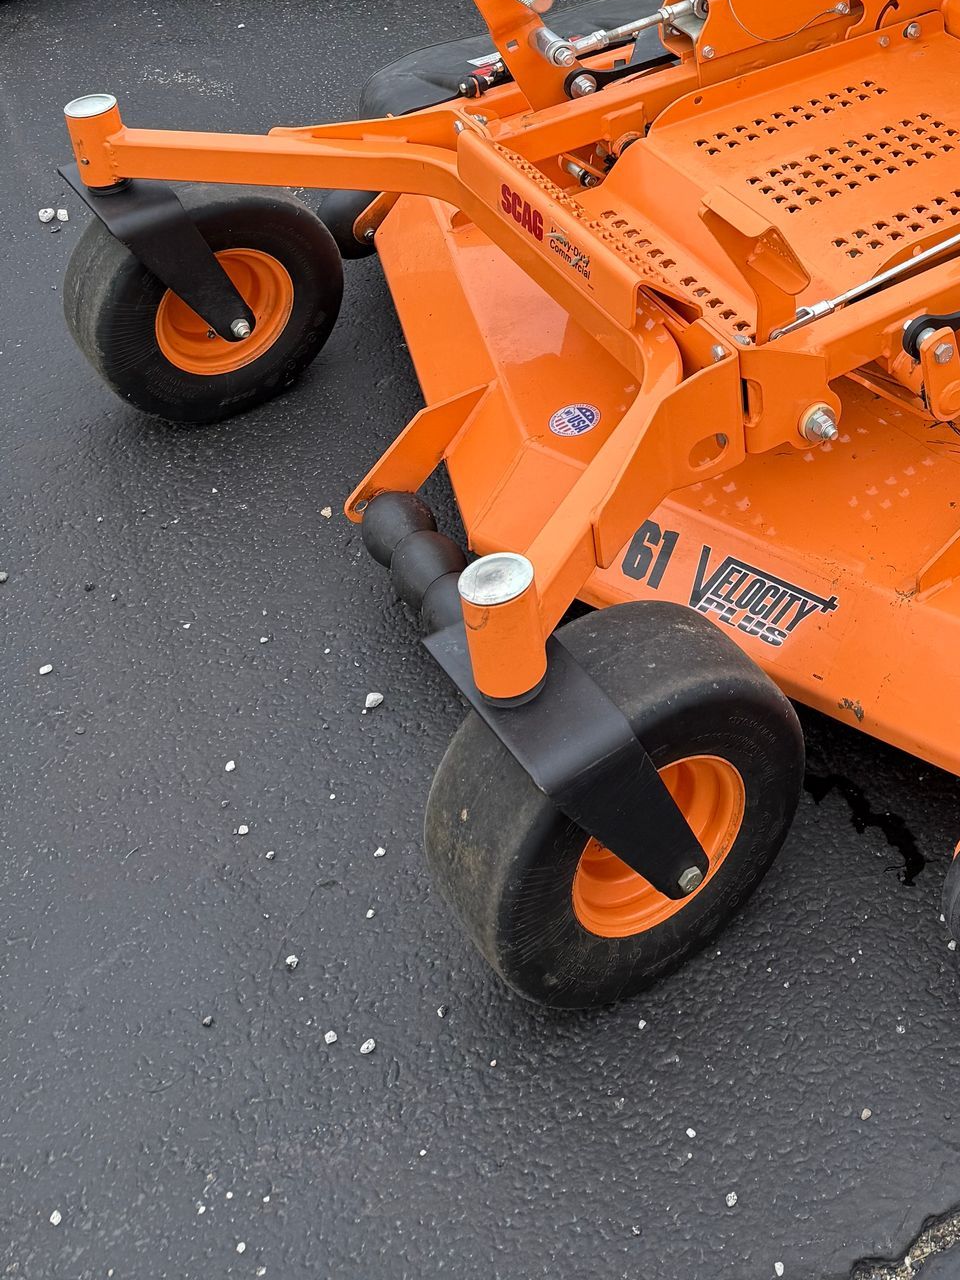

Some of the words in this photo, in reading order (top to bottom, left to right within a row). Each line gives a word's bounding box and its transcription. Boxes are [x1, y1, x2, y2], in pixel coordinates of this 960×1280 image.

[501, 183, 544, 242] SCAG
[550, 238, 591, 280] Commrcial
[567, 414, 591, 433] USA
[621, 519, 680, 590] 61
[697, 595, 788, 647] PLUS
